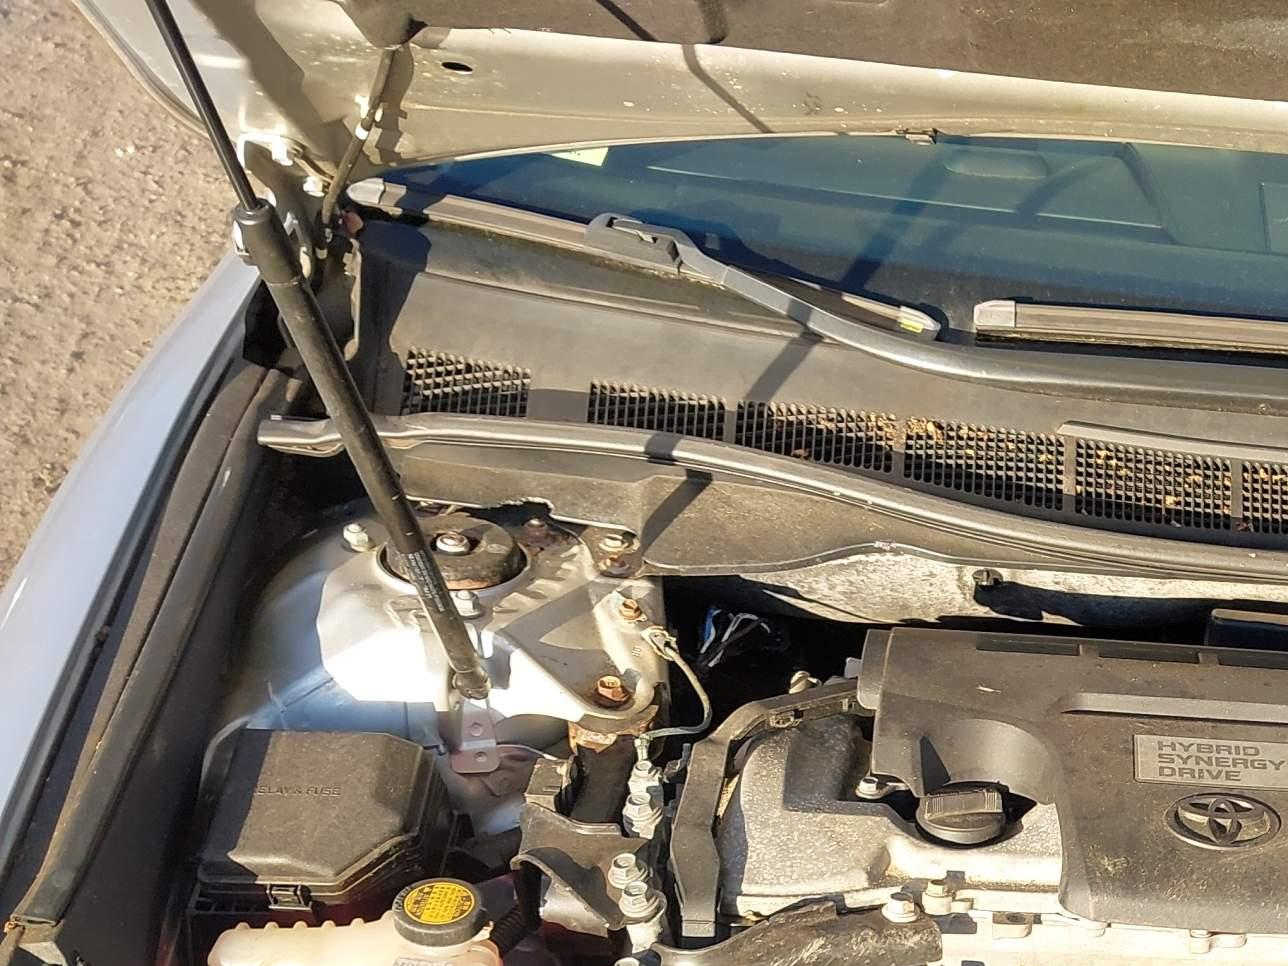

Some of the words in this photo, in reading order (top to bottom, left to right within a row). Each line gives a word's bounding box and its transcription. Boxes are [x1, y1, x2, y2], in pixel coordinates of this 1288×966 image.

[1157, 740, 1260, 757] HYBRID
[1157, 752, 1286, 771] SYNERGY
[1158, 765, 1241, 782] DRIVE
[305, 785, 341, 797] FUSE
